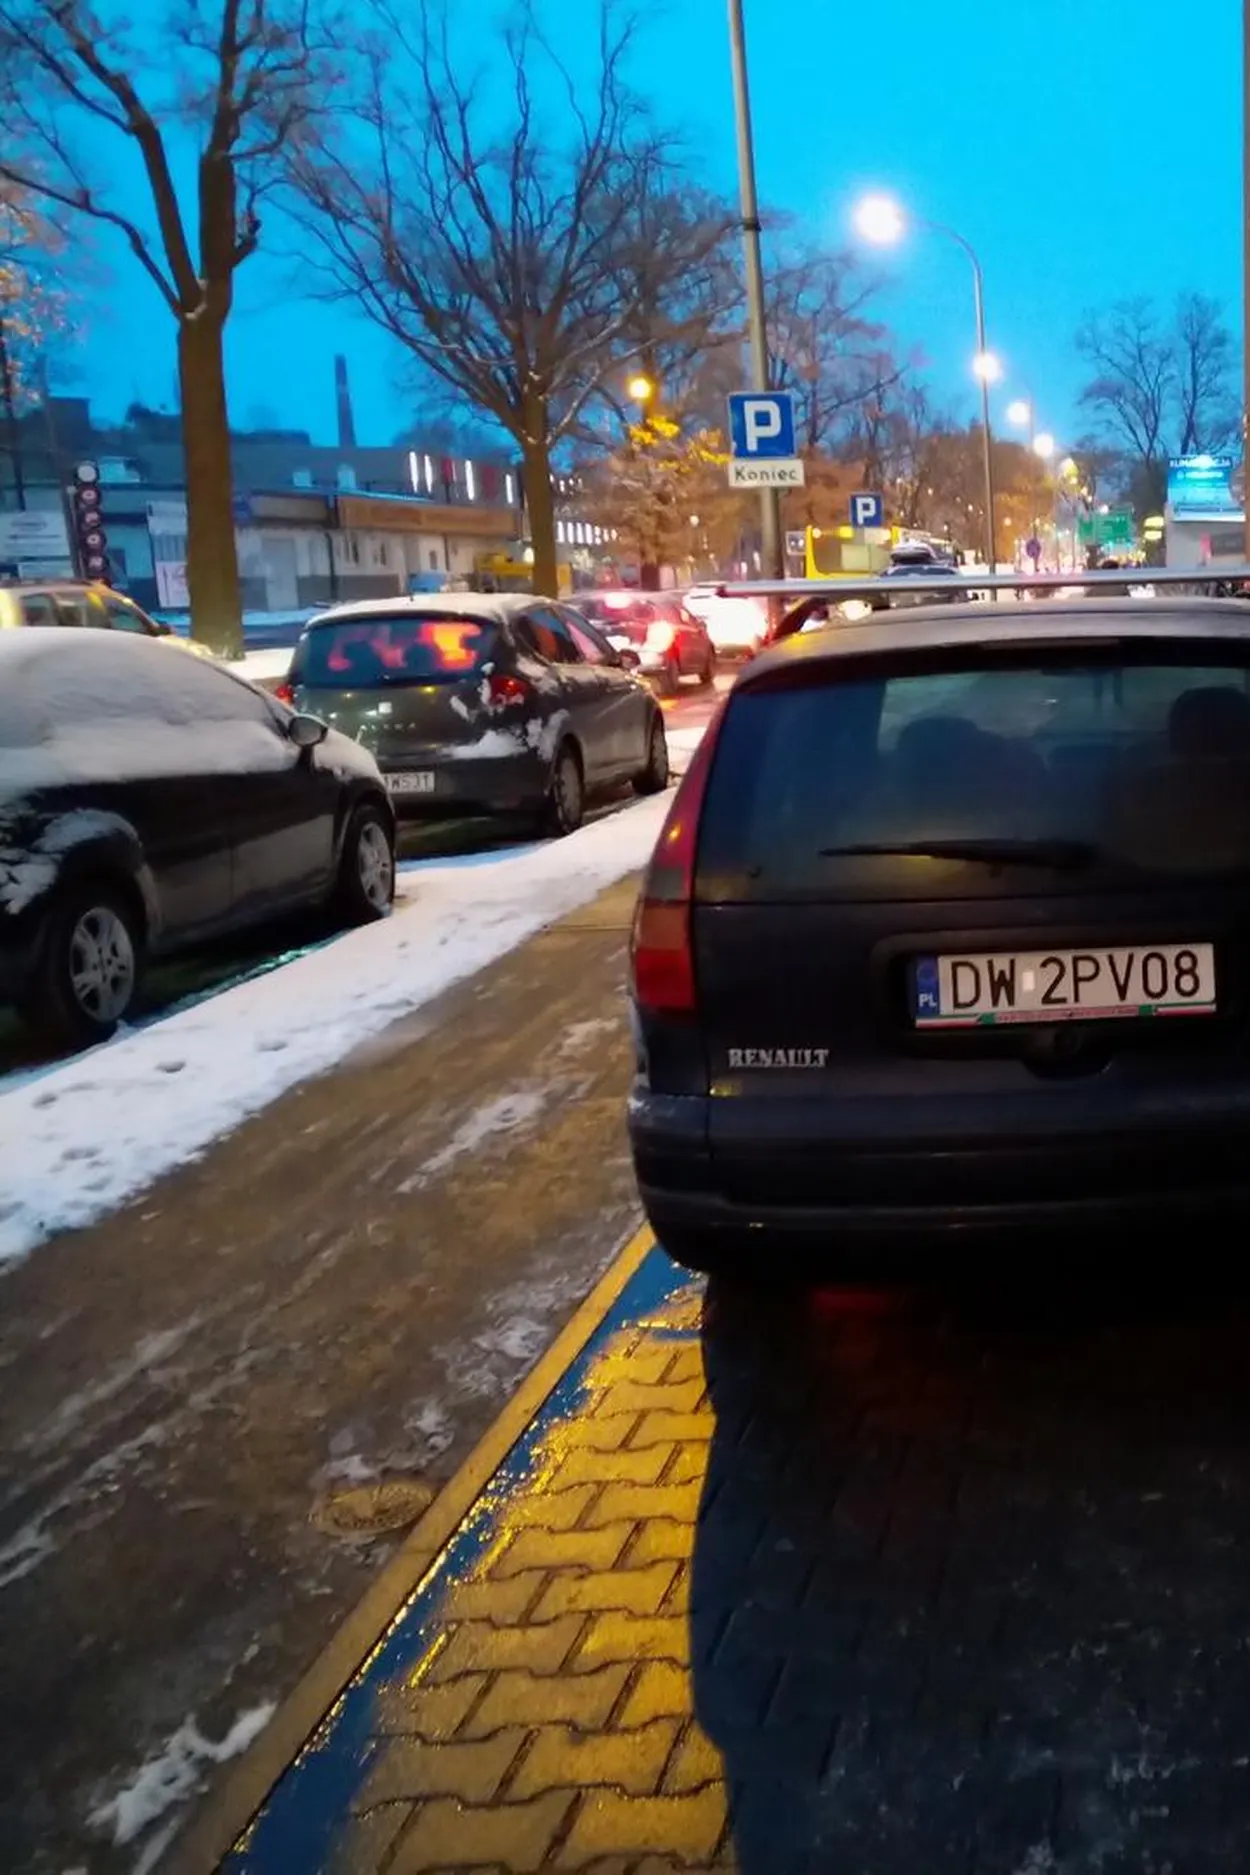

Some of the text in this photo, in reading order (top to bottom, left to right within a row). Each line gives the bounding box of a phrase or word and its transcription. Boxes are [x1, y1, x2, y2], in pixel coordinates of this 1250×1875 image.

[744, 400, 782, 452] P
[734, 466, 798, 482] Koniec
[856, 497, 876, 525] P
[951, 949, 1201, 1009] DW 2PV08
[918, 993, 937, 1008] PL
[729, 1047, 830, 1069] RENAULT
